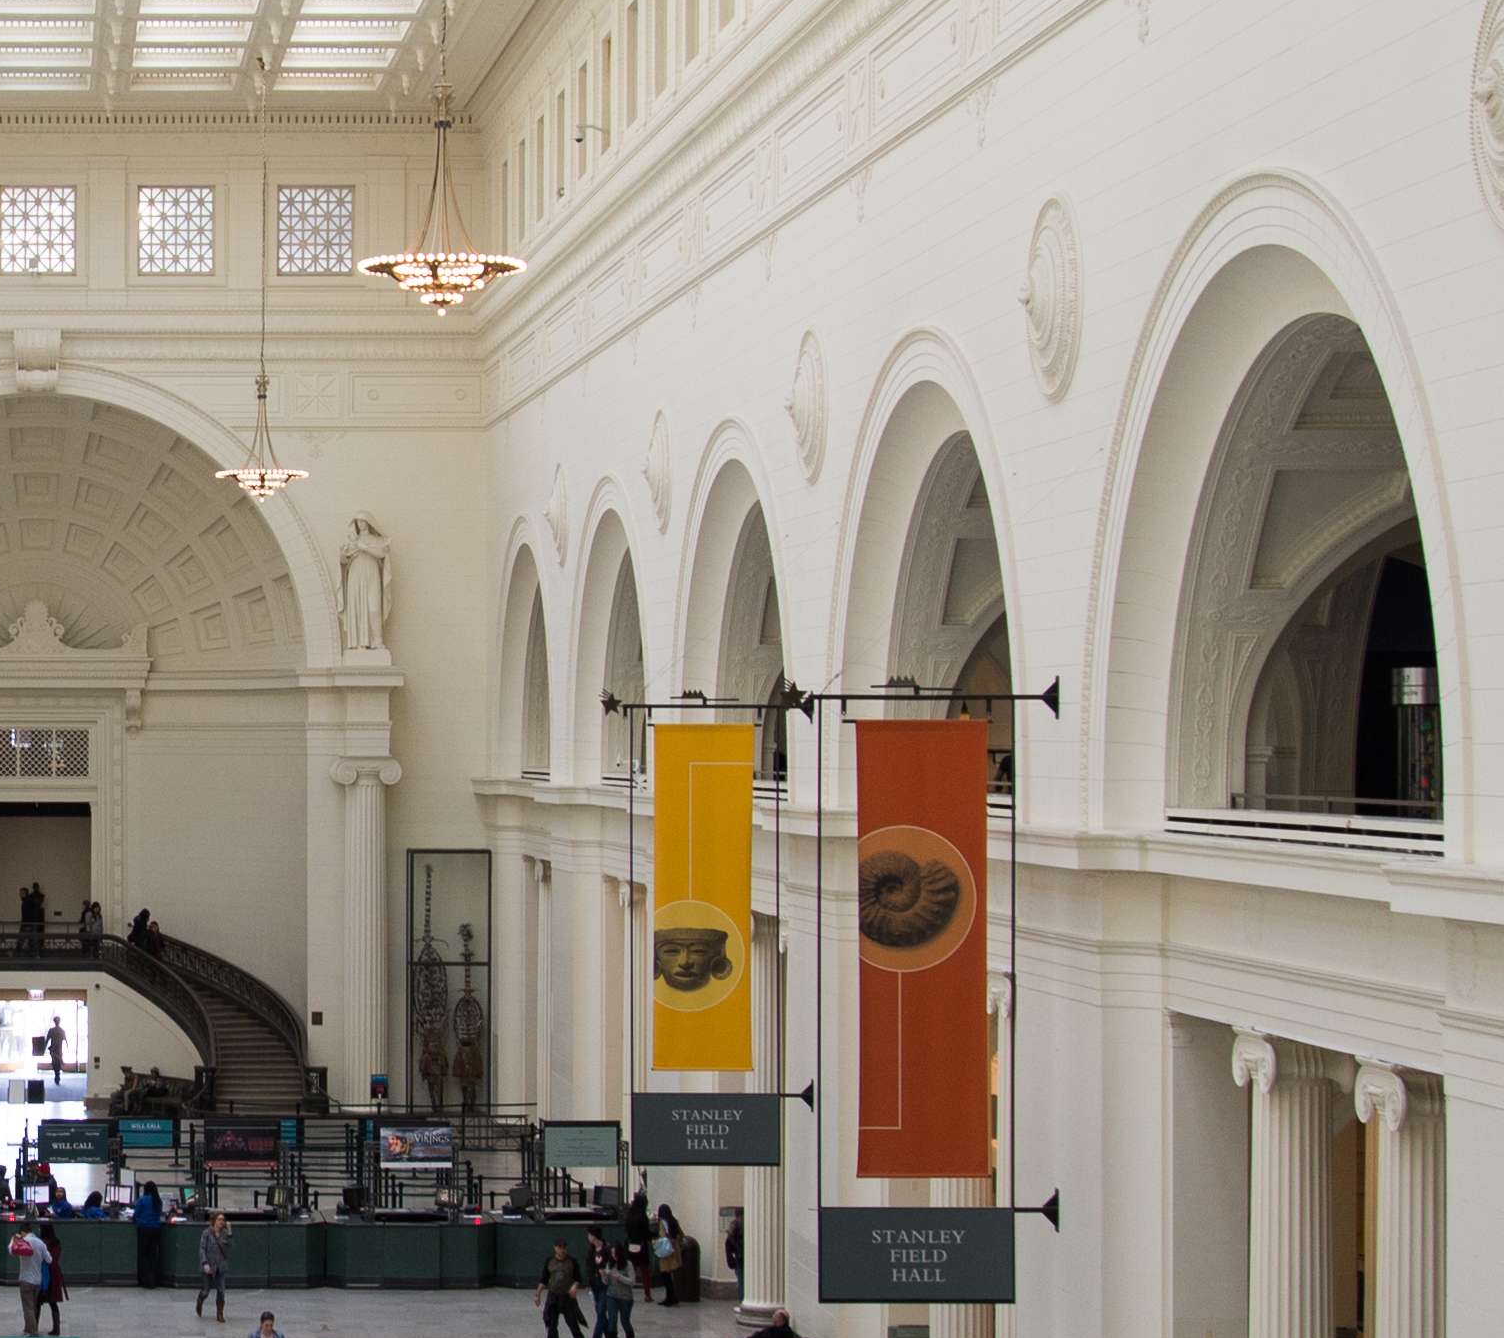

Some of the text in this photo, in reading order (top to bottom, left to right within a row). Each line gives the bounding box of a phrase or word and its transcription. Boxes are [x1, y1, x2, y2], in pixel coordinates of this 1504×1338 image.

[671, 1109, 743, 1121] STANLEY
[686, 1124, 729, 1135] FIELD
[414, 1132, 451, 1144] VIKINGS
[52, 1142, 95, 1150] WILL CALL
[687, 1139, 728, 1150] HALL
[871, 1229, 967, 1244] STANLEY
[890, 1249, 948, 1263] FIELD
[892, 1268, 946, 1282] HALL
